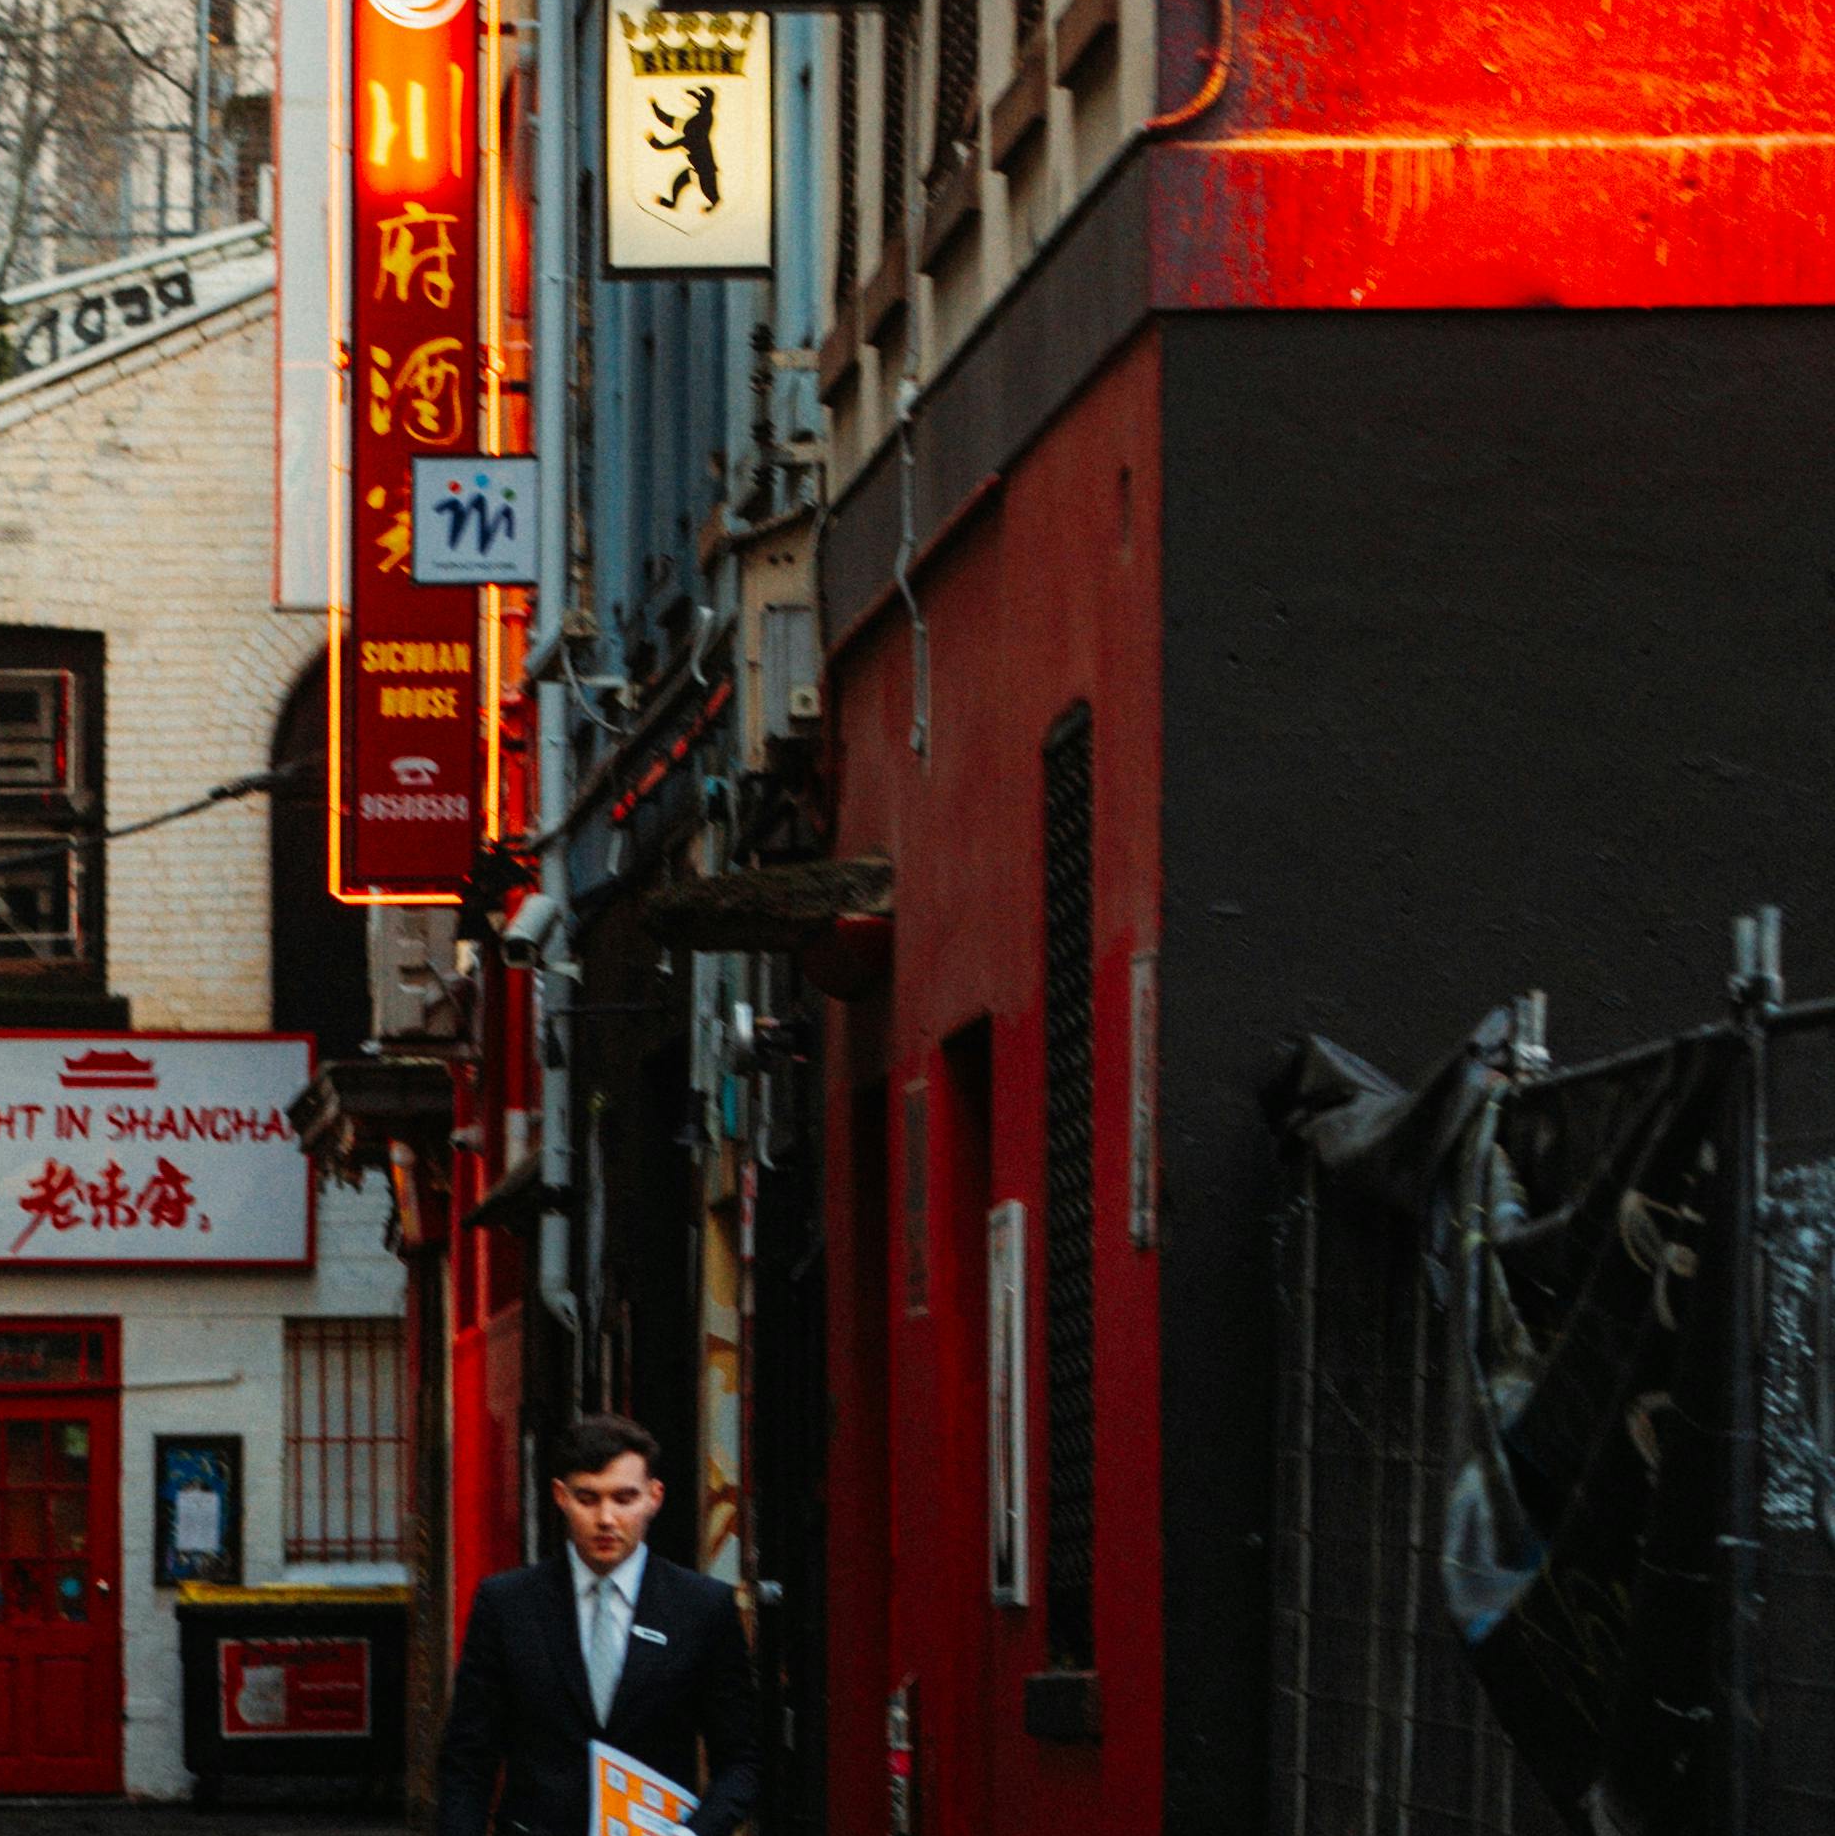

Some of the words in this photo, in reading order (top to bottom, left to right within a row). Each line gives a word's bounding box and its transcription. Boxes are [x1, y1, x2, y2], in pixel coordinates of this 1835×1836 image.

[362, 641, 471, 673] SICHUAN
[380, 686, 459, 719] HOUSE
[55, 1103, 92, 1141] IN
[106, 1104, 296, 1143] SHANGHA
